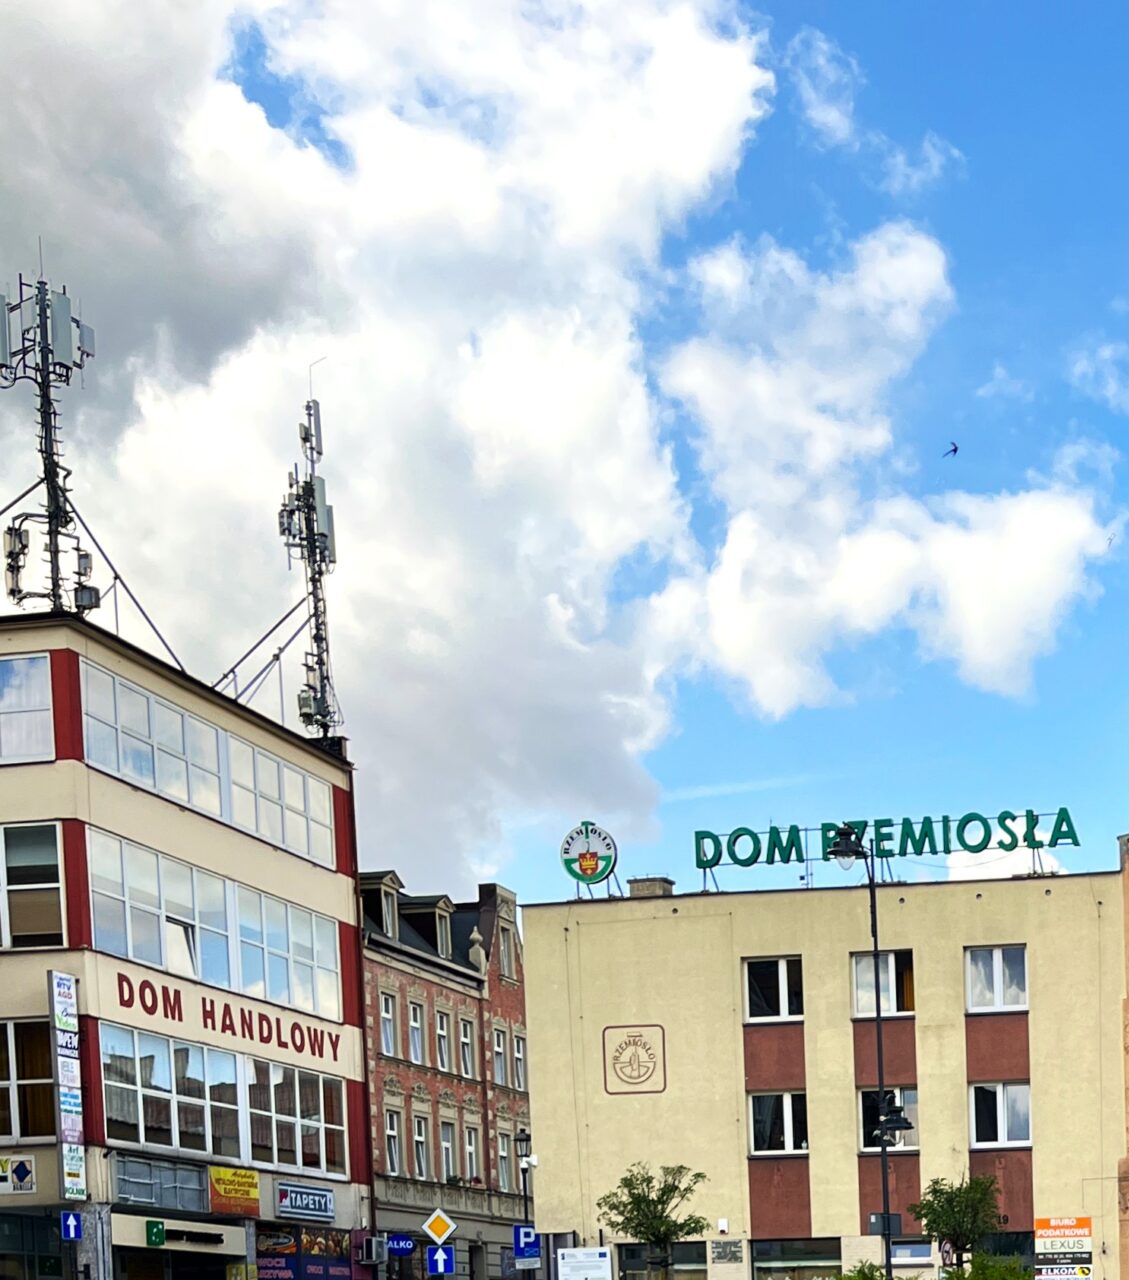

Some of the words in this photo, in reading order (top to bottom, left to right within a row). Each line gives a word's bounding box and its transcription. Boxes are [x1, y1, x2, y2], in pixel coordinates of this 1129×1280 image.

[694, 824, 805, 869] DOM
[117, 972, 183, 1022] DOM
[201, 996, 340, 1062] HANDLOWY
[612, 1038, 656, 1061] RZEMIOSŁO
[290, 1193, 327, 1210] TAPETY
[1050, 1218, 1076, 1227] BIURO
[520, 1227, 536, 1248] P
[1037, 1228, 1090, 1237] PODATKOWE
[387, 1240, 414, 1249] ALKO
[1043, 1239, 1085, 1250] LEXUS
[257, 1257, 286, 1268] WOCE
[1041, 1267, 1078, 1276] ELKOM
